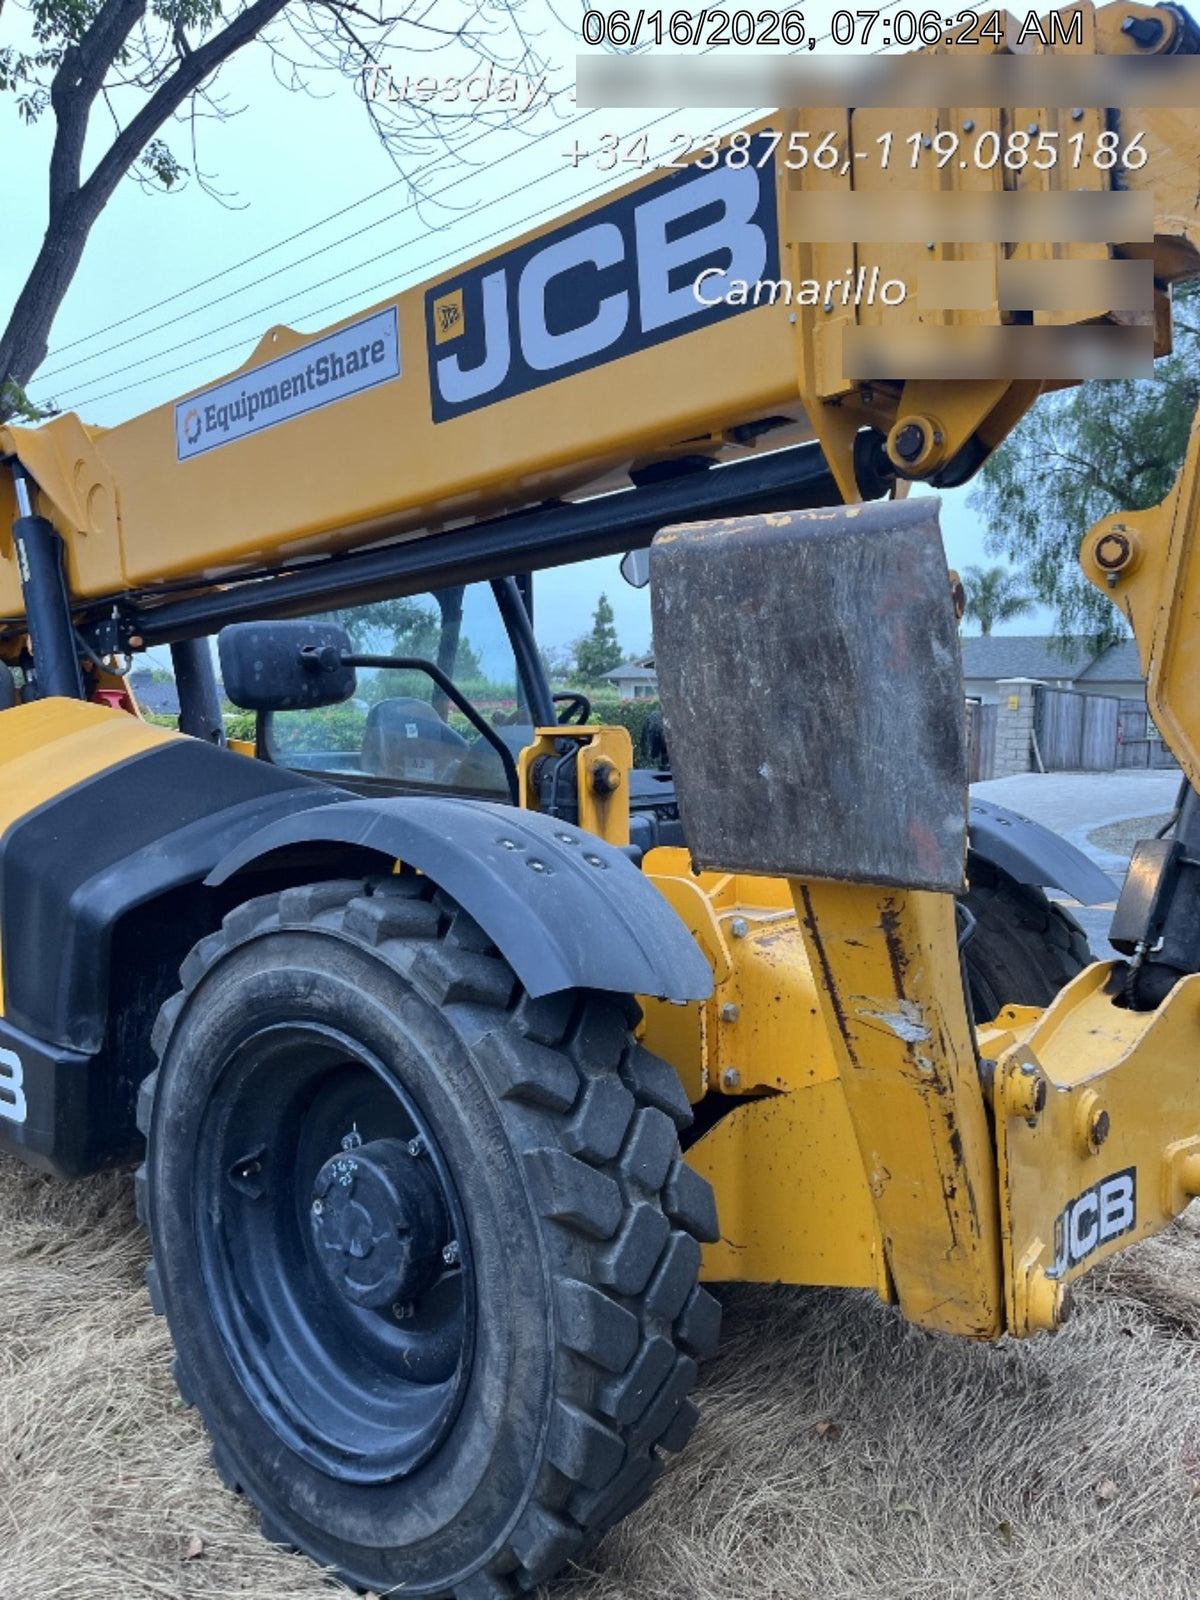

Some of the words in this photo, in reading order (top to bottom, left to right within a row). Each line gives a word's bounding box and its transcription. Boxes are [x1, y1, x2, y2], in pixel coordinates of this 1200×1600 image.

[436, 163, 769, 403] JCB
[203, 338, 386, 433] EquipmentShare
[1044, 1174, 1134, 1279] JCB
